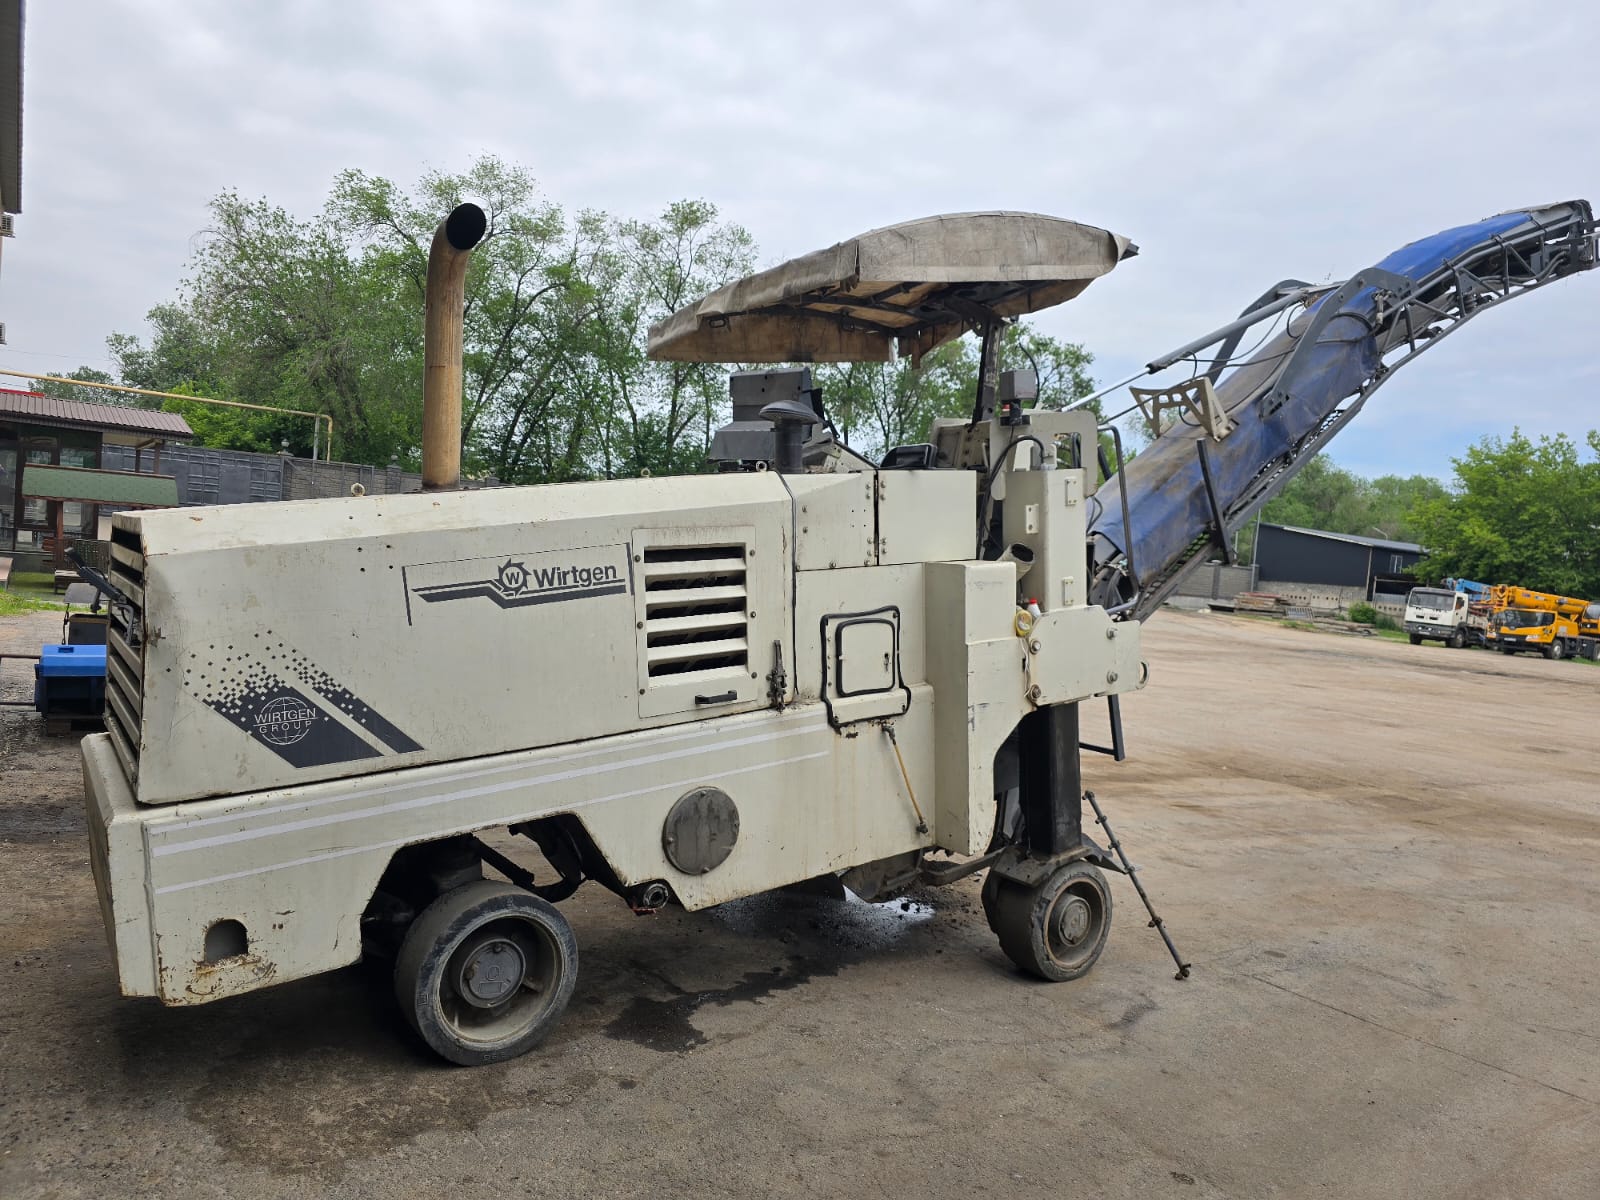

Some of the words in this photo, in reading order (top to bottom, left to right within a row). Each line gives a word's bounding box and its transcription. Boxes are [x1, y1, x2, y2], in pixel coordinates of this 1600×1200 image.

[505, 571, 520, 586] W
[532, 565, 617, 588] Wirtgen
[253, 707, 317, 724] WIRTGEN
[259, 720, 312, 734] GROUP
